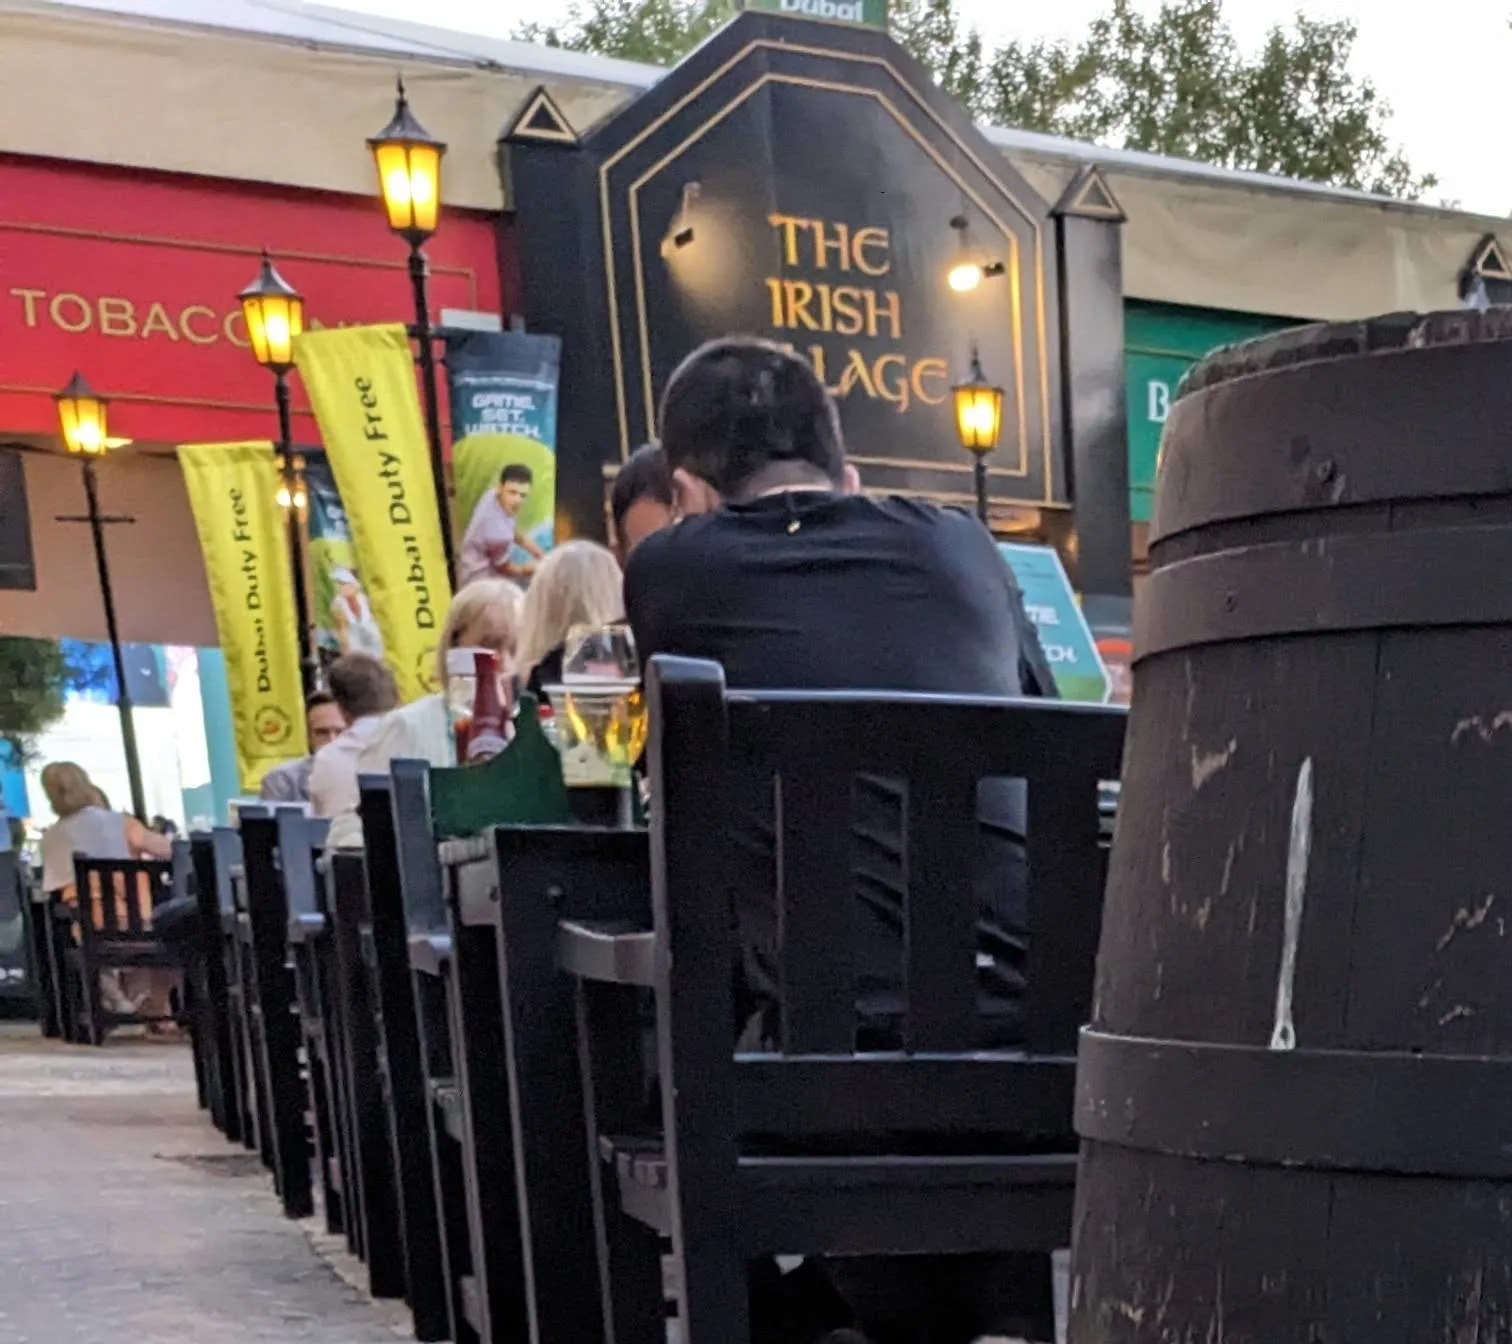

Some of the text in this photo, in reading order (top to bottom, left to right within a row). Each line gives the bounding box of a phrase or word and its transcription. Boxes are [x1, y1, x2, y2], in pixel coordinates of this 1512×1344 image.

[767, 212, 891, 277] THE
[10, 288, 315, 348] TOBACC
[765, 277, 902, 339] IRISH
[806, 344, 949, 413] LAGE
[354, 376, 435, 630] Dubai Duty Free
[228, 487, 272, 693] Dubai Duty Free
